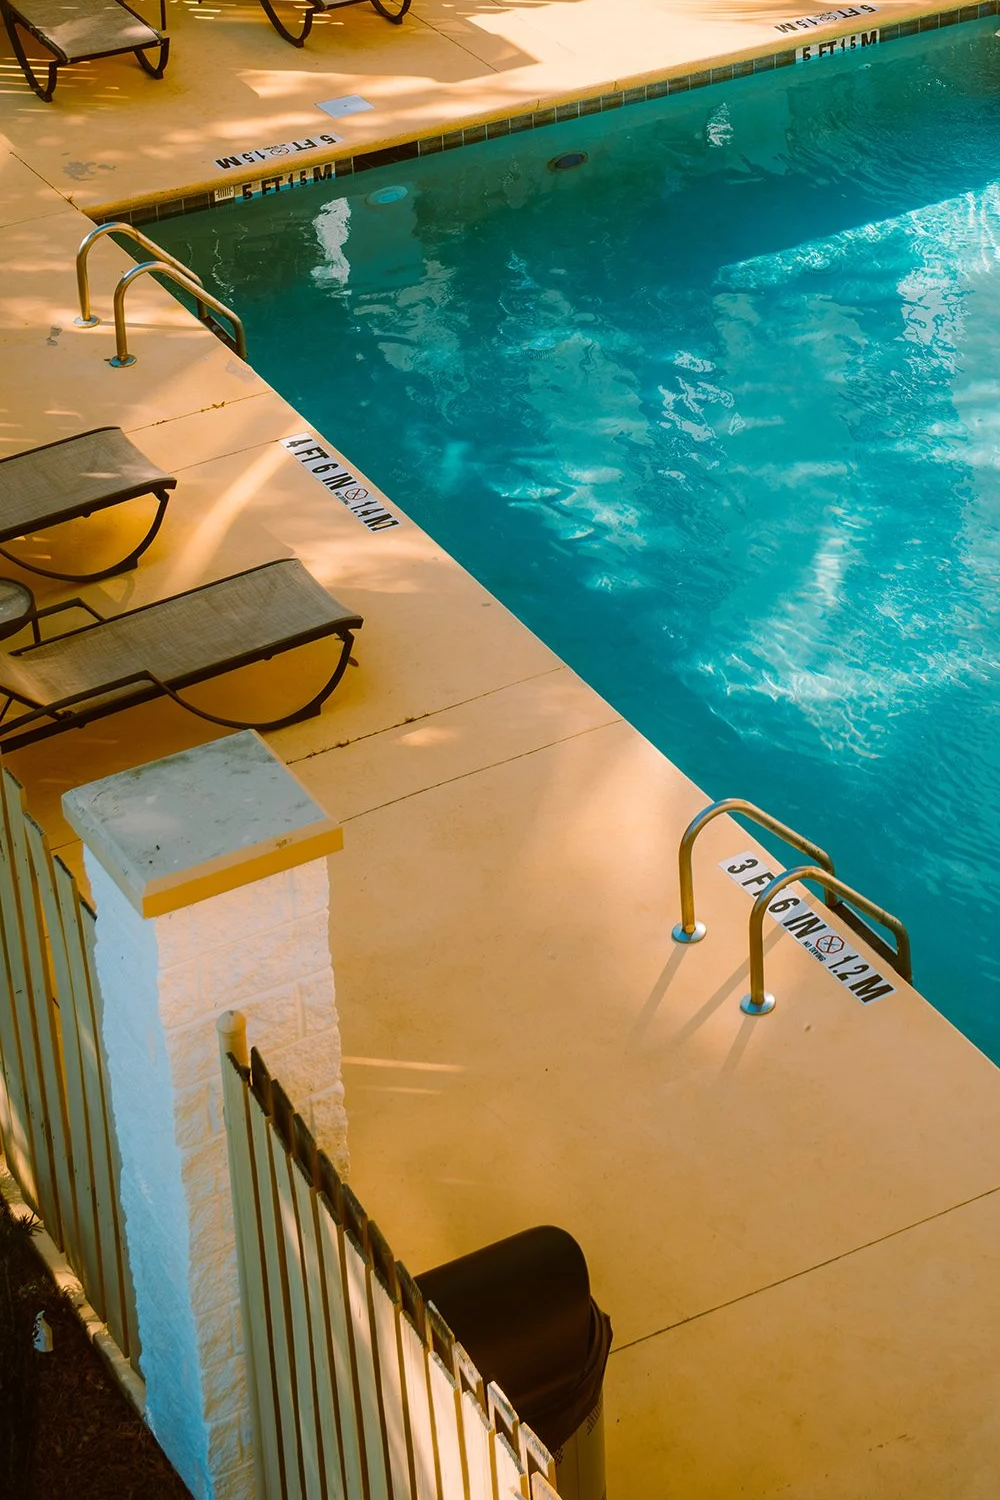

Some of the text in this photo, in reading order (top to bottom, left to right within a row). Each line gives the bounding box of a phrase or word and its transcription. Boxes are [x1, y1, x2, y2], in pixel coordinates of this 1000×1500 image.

[837, 8, 860, 18] FT
[774, 23, 798, 33] M
[803, 46, 811, 61] 5
[819, 40, 837, 57] FT
[861, 31, 876, 47] M
[292, 139, 318, 151] FT
[320, 135, 336, 144] 5
[242, 150, 265, 162] 1.5
[216, 157, 242, 169] M
[242, 184, 253, 200] 5
[261, 176, 283, 195] FT
[313, 164, 332, 182] M
[286, 438, 399, 532] 4 FT 6 IN 1.4 M
[727, 859, 894, 1003] 3 F 6 IN 1.2 M
